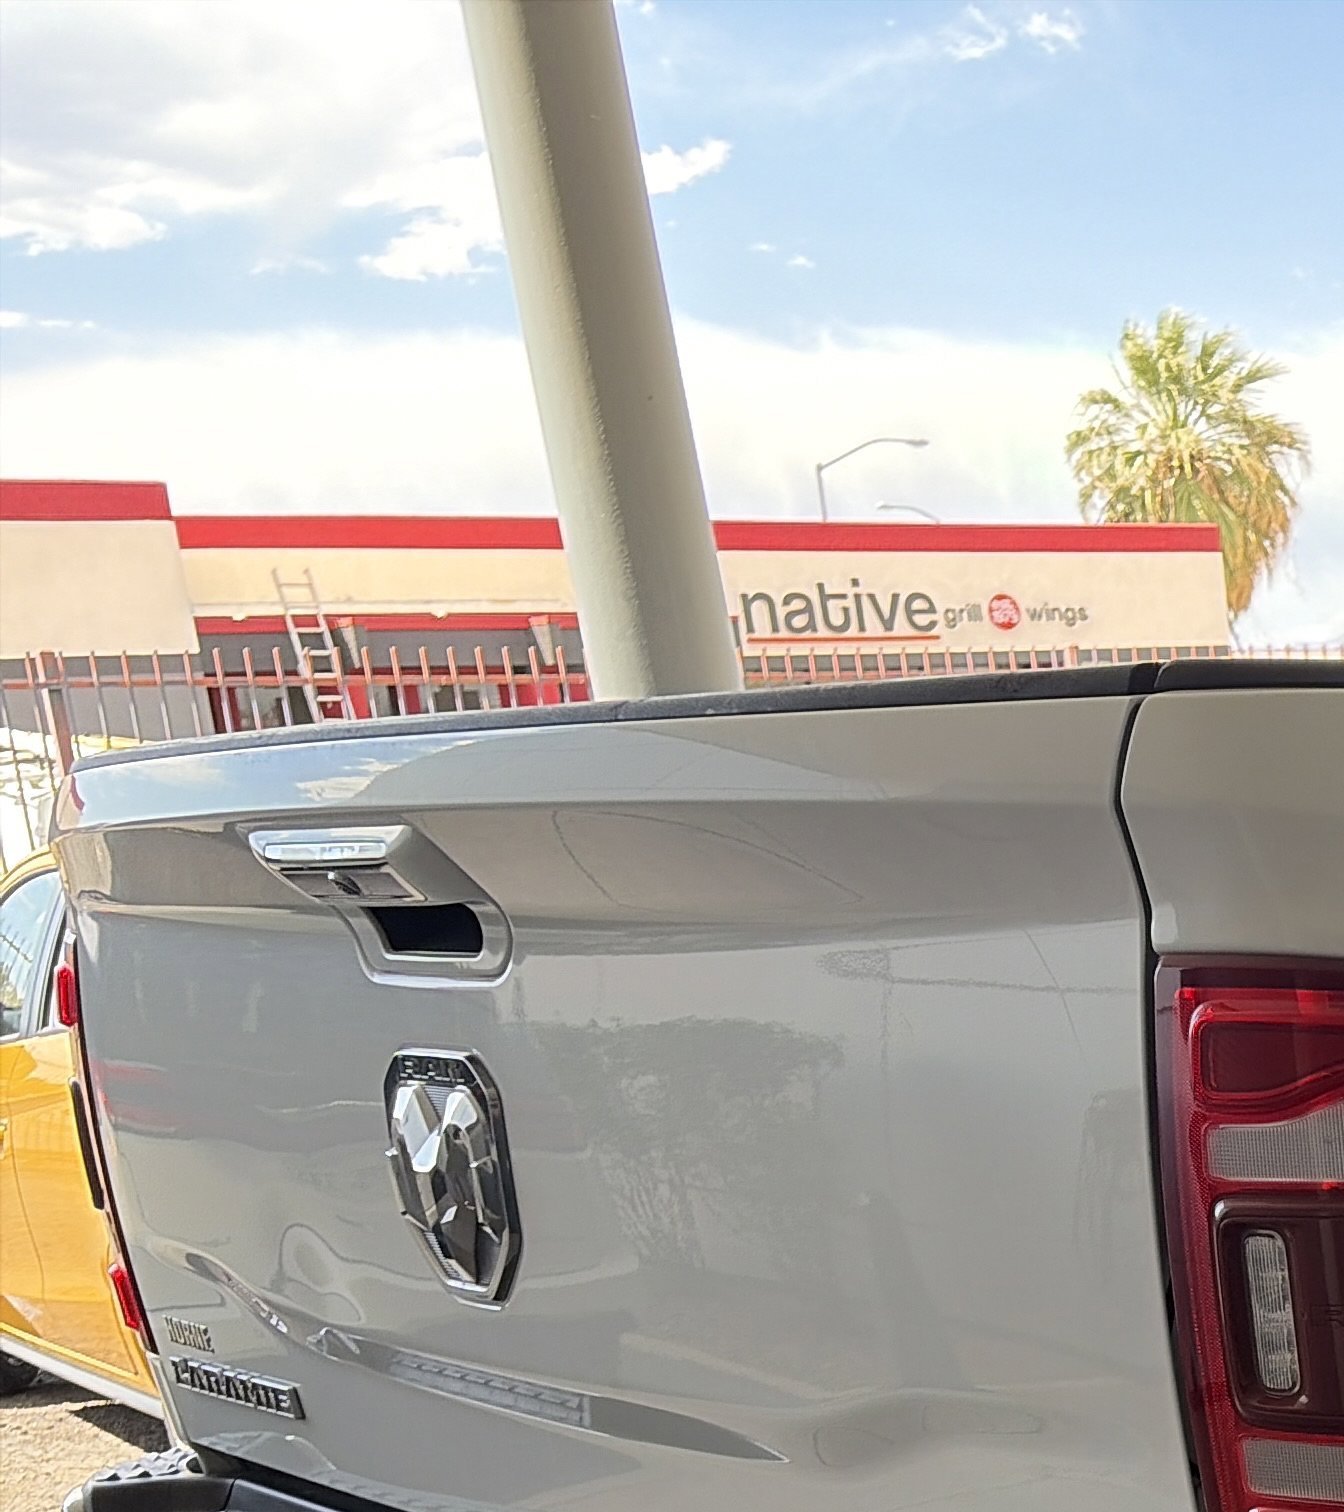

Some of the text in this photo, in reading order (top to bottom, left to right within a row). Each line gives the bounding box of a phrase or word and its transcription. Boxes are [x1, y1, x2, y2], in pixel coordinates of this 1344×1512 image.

[740, 578, 939, 634] native
[943, 603, 983, 629] grill
[1025, 602, 1089, 627] wings
